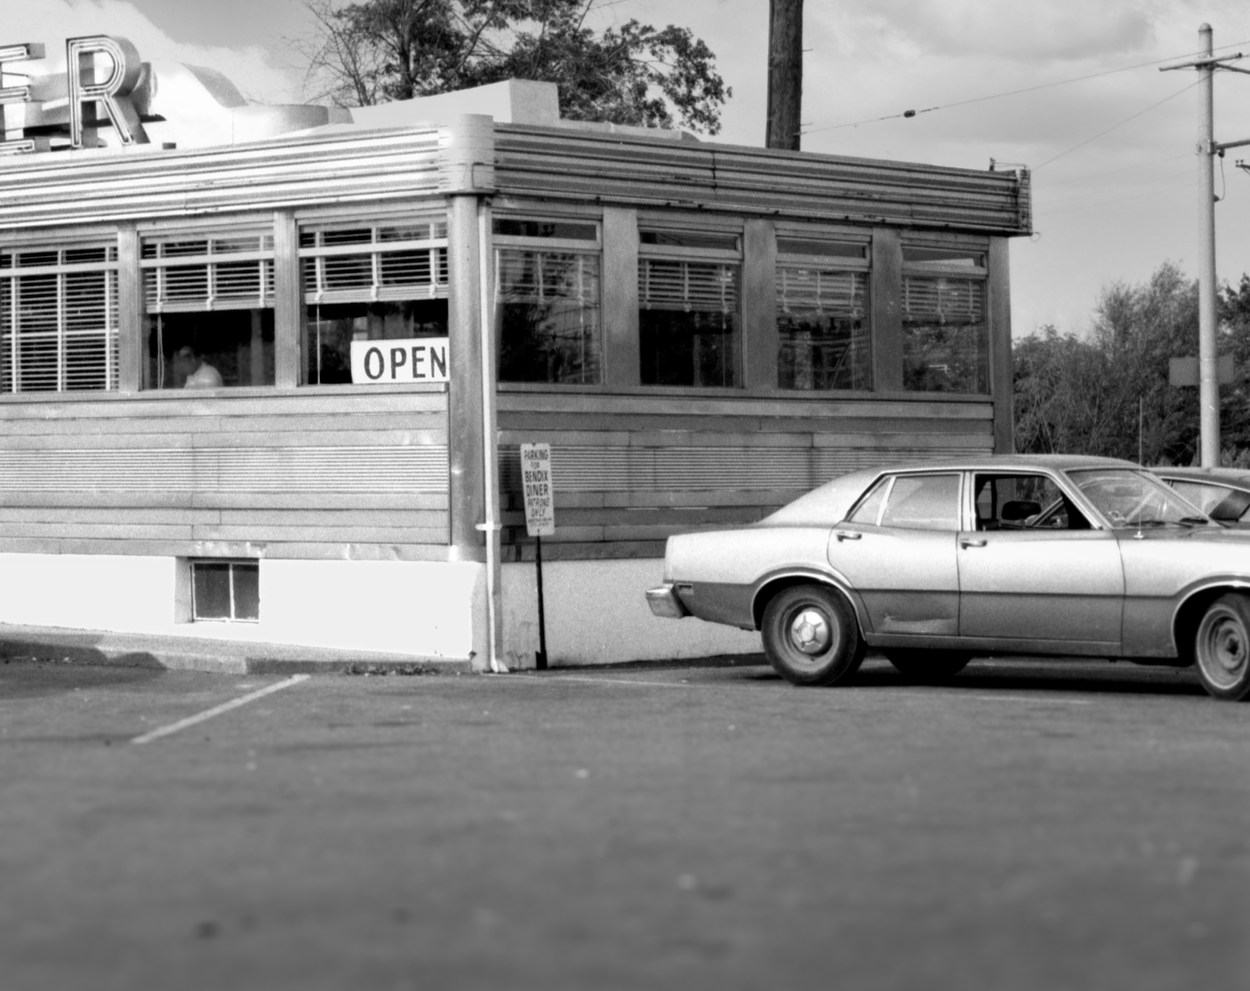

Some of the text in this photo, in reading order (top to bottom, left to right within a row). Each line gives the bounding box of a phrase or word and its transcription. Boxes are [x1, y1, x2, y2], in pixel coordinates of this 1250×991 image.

[363, 345, 447, 380] OPEN
[523, 449, 549, 460] PARKING
[524, 470, 549, 482] BENDIX
[525, 483, 549, 497] DINER
[527, 497, 550, 507] PATRONS
[530, 508, 546, 518] ONLY
